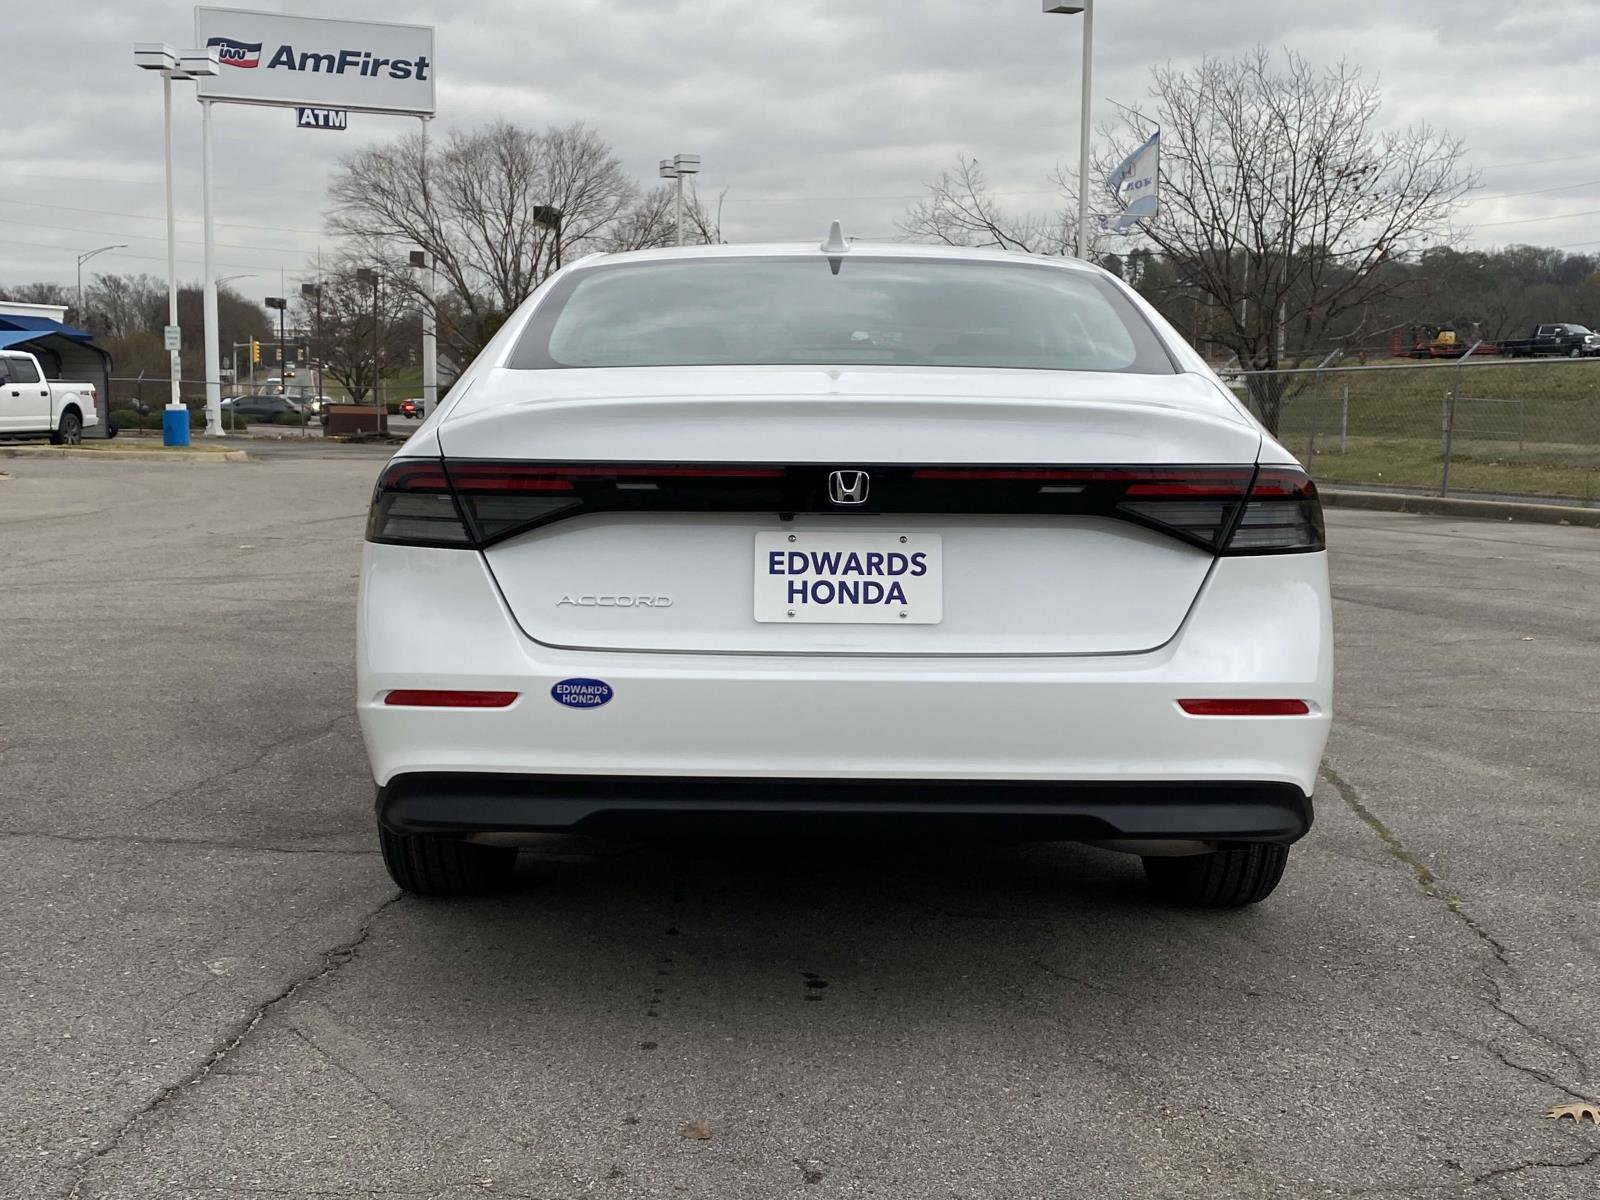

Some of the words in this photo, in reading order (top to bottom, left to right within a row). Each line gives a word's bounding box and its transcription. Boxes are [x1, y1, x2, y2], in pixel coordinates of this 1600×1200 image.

[266, 44, 430, 81] AmFirst
[300, 108, 346, 128] ATM
[769, 552, 927, 576] EDWARDS
[556, 594, 673, 608] ACCORD
[787, 580, 908, 605] HONDA
[556, 684, 609, 695] EDWARDS
[562, 694, 602, 704] HONDA
